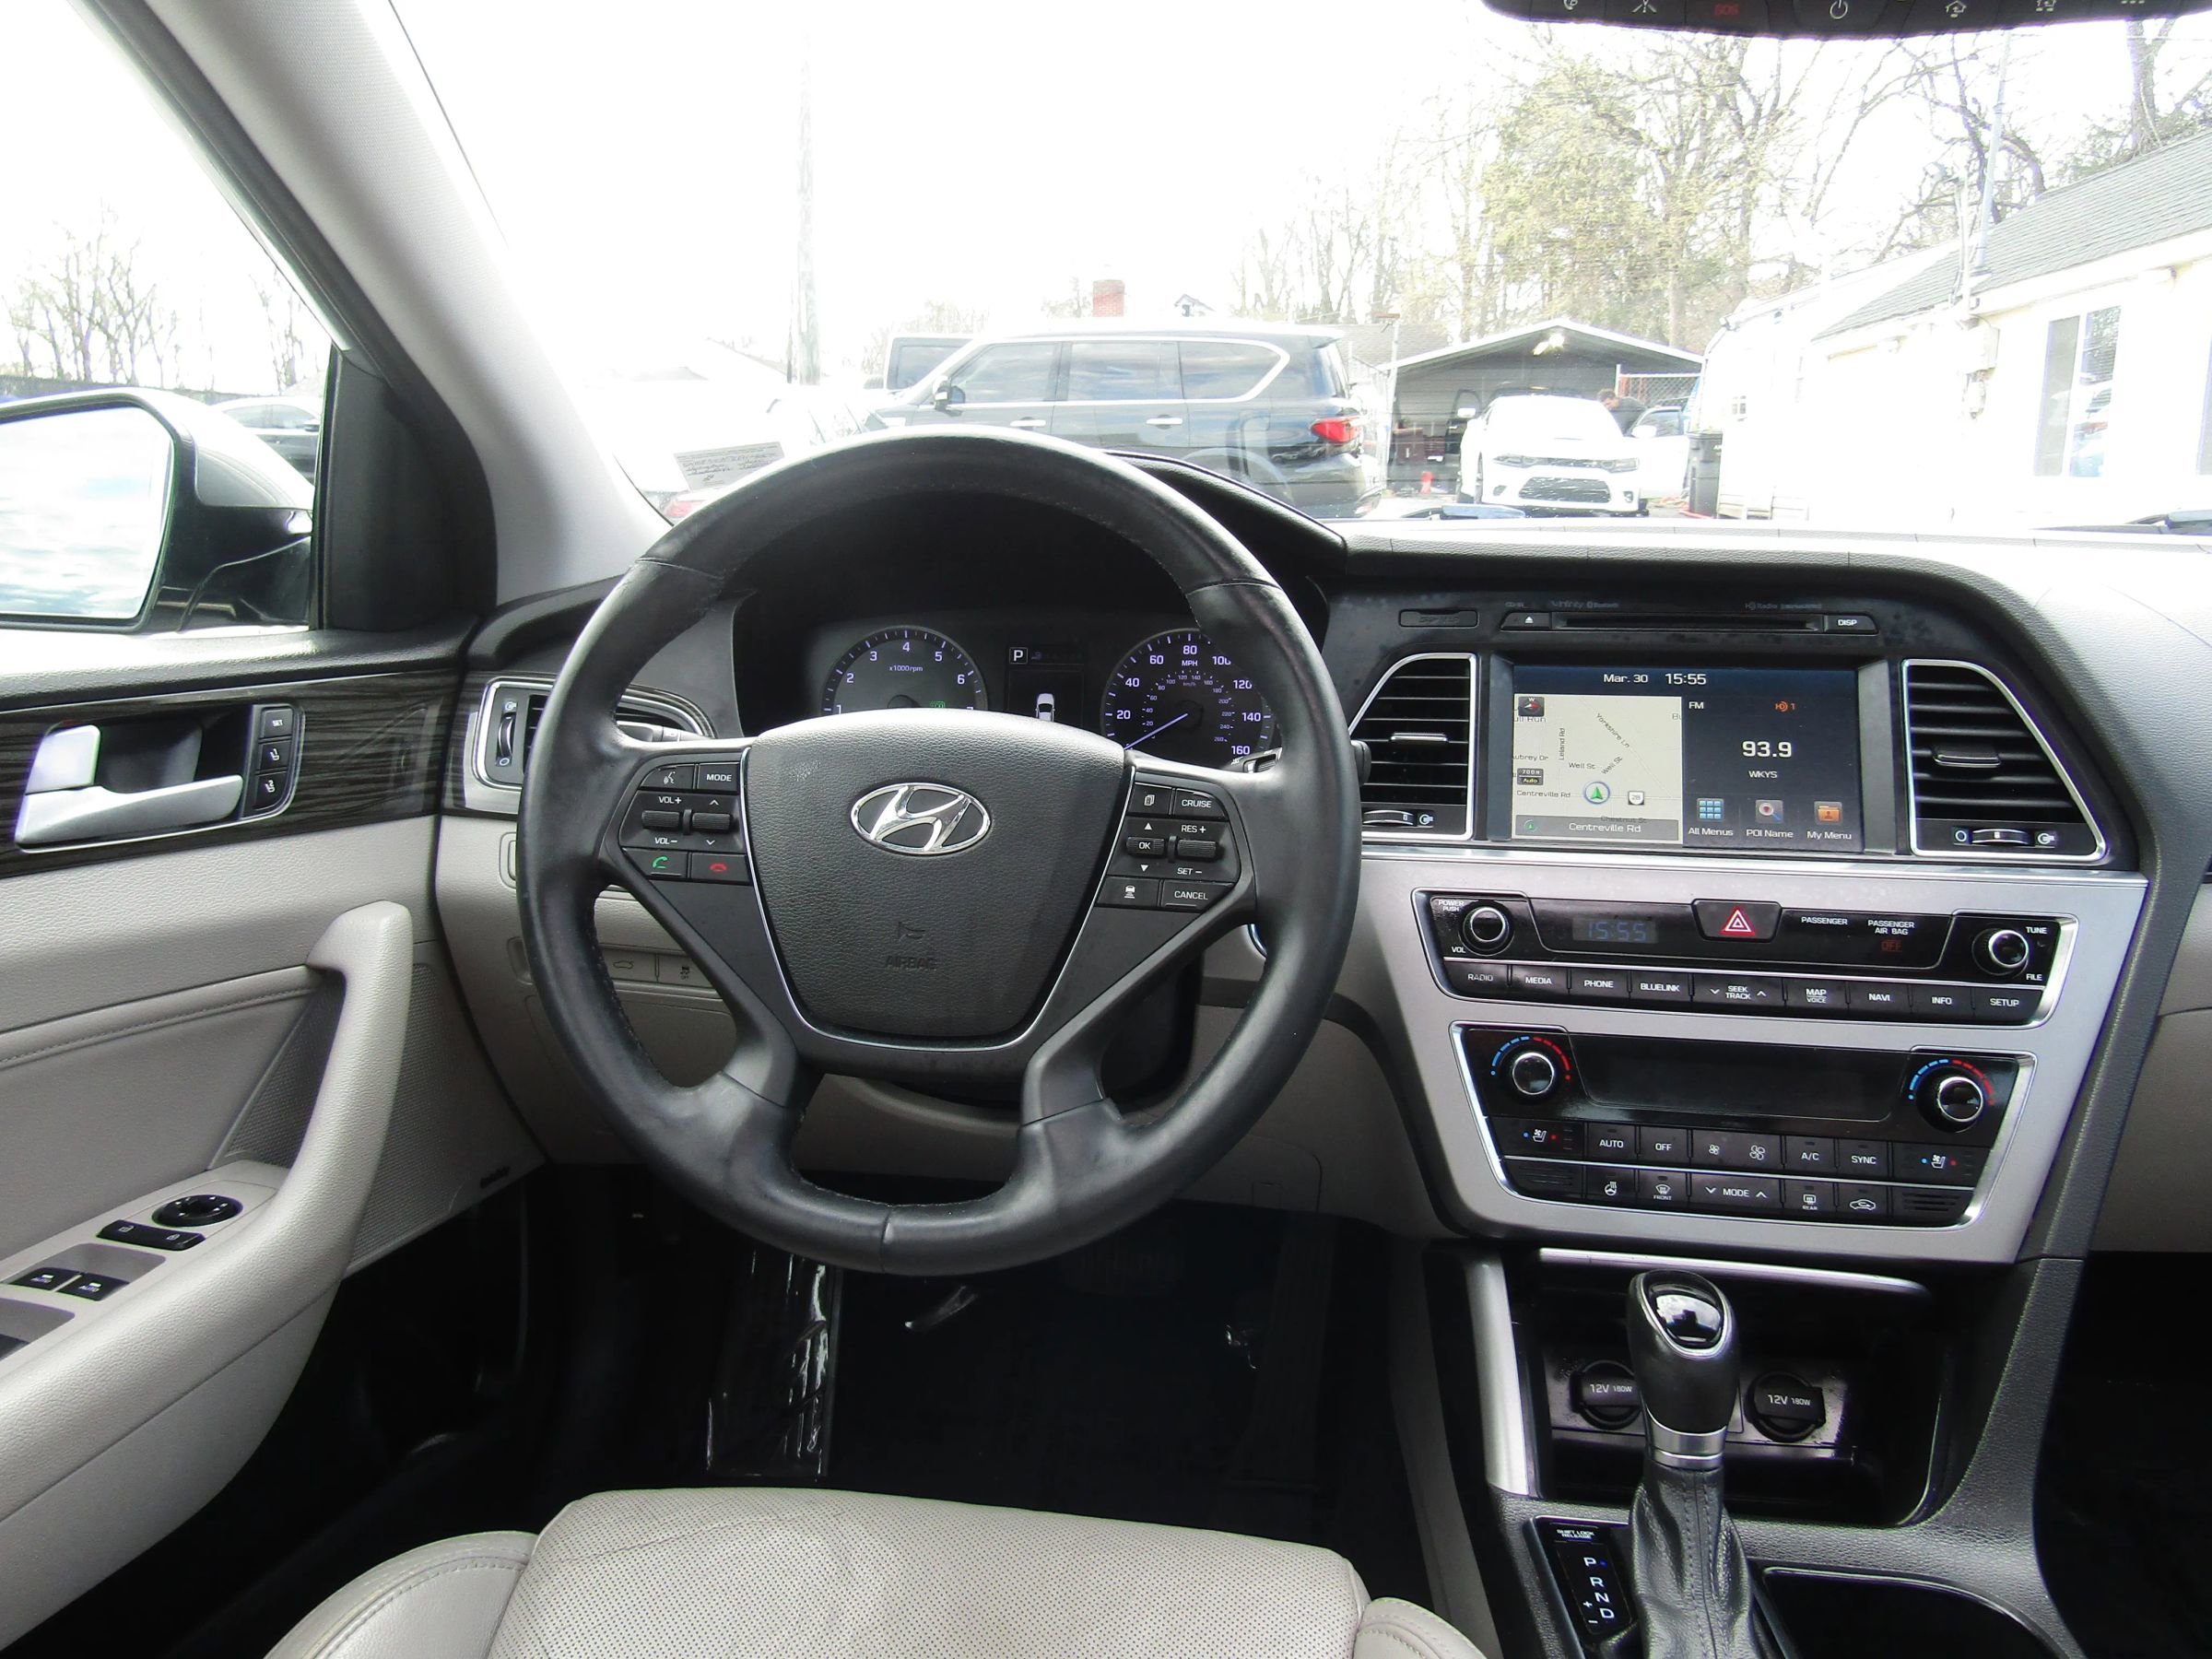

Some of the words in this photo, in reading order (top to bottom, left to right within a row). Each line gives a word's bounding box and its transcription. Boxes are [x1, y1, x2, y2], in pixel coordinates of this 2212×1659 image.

[1838, 618, 1857, 627] DISP
[903, 641, 911, 652] 4
[1182, 645, 1197, 654] 80
[869, 651, 877, 662] 3
[935, 651, 943, 662] 5
[1013, 649, 1024, 662] P
[1149, 655, 1164, 665] 60
[1212, 656, 1231, 665] 100
[846, 674, 854, 684] 2
[957, 674, 965, 685] 6
[1124, 677, 1140, 688] 40
[1604, 674, 1630, 683] Mar.
[1634, 674, 1648, 683] 30
[1665, 673, 1706, 685] 15:55
[1233, 679, 1252, 689] 120
[1116, 710, 1131, 719] 20
[1241, 712, 1261, 722] 140
[1595, 712, 1622, 741] Yorkshire
[1231, 745, 1251, 755] 160
[1742, 740, 1793, 758] 93.9
[706, 773, 733, 782] MODE
[1748, 771, 1778, 779] WKYS
[1181, 799, 1212, 808] CRUISE
[1569, 822, 1624, 832] Centreville
[1626, 824, 1641, 833] Rd
[1688, 827, 1700, 836] All
[1701, 828, 1734, 837] Menus
[1747, 829, 1763, 838] POI
[1765, 830, 1794, 839] Name
[1806, 831, 1822, 841] My
[1824, 831, 1852, 840] Menu
[1138, 841, 1151, 850] OK
[1177, 867, 1194, 876] SET
[1174, 890, 1208, 900] CANCEL
[1801, 916, 1848, 925] PASSENGER
[1867, 920, 1914, 928] PASSENGER
[2026, 926, 2047, 935] TUNE
[1451, 946, 1466, 954] VOL
[1467, 973, 1494, 982] RADIO
[1525, 976, 1551, 985] MEDIA
[2026, 973, 2042, 982] FILE
[1583, 980, 1614, 988] PHONE
[1640, 982, 1680, 993] BLUELINK
[1725, 992, 1751, 1000] TRACK
[1806, 988, 1827, 996] MAP
[1868, 993, 1890, 1002] NAVI
[1932, 996, 1952, 1005] INFO
[1990, 998, 2019, 1006] SETUP
[1599, 1139, 1624, 1148] AUTO
[1654, 1142, 1673, 1151] OFF
[1801, 1152, 1819, 1161] A/C
[1851, 1155, 1877, 1164] SYNC
[1723, 1188, 1750, 1197] MODE
[1590, 1383, 1609, 1394] 12V
[1768, 1394, 1788, 1405] 12V
[1791, 1397, 1811, 1406] 180W
[1583, 1557, 1596, 1567] P
[1590, 1577, 1604, 1587] R
[1594, 1592, 1609, 1603] N
[1600, 1607, 1615, 1618] D
